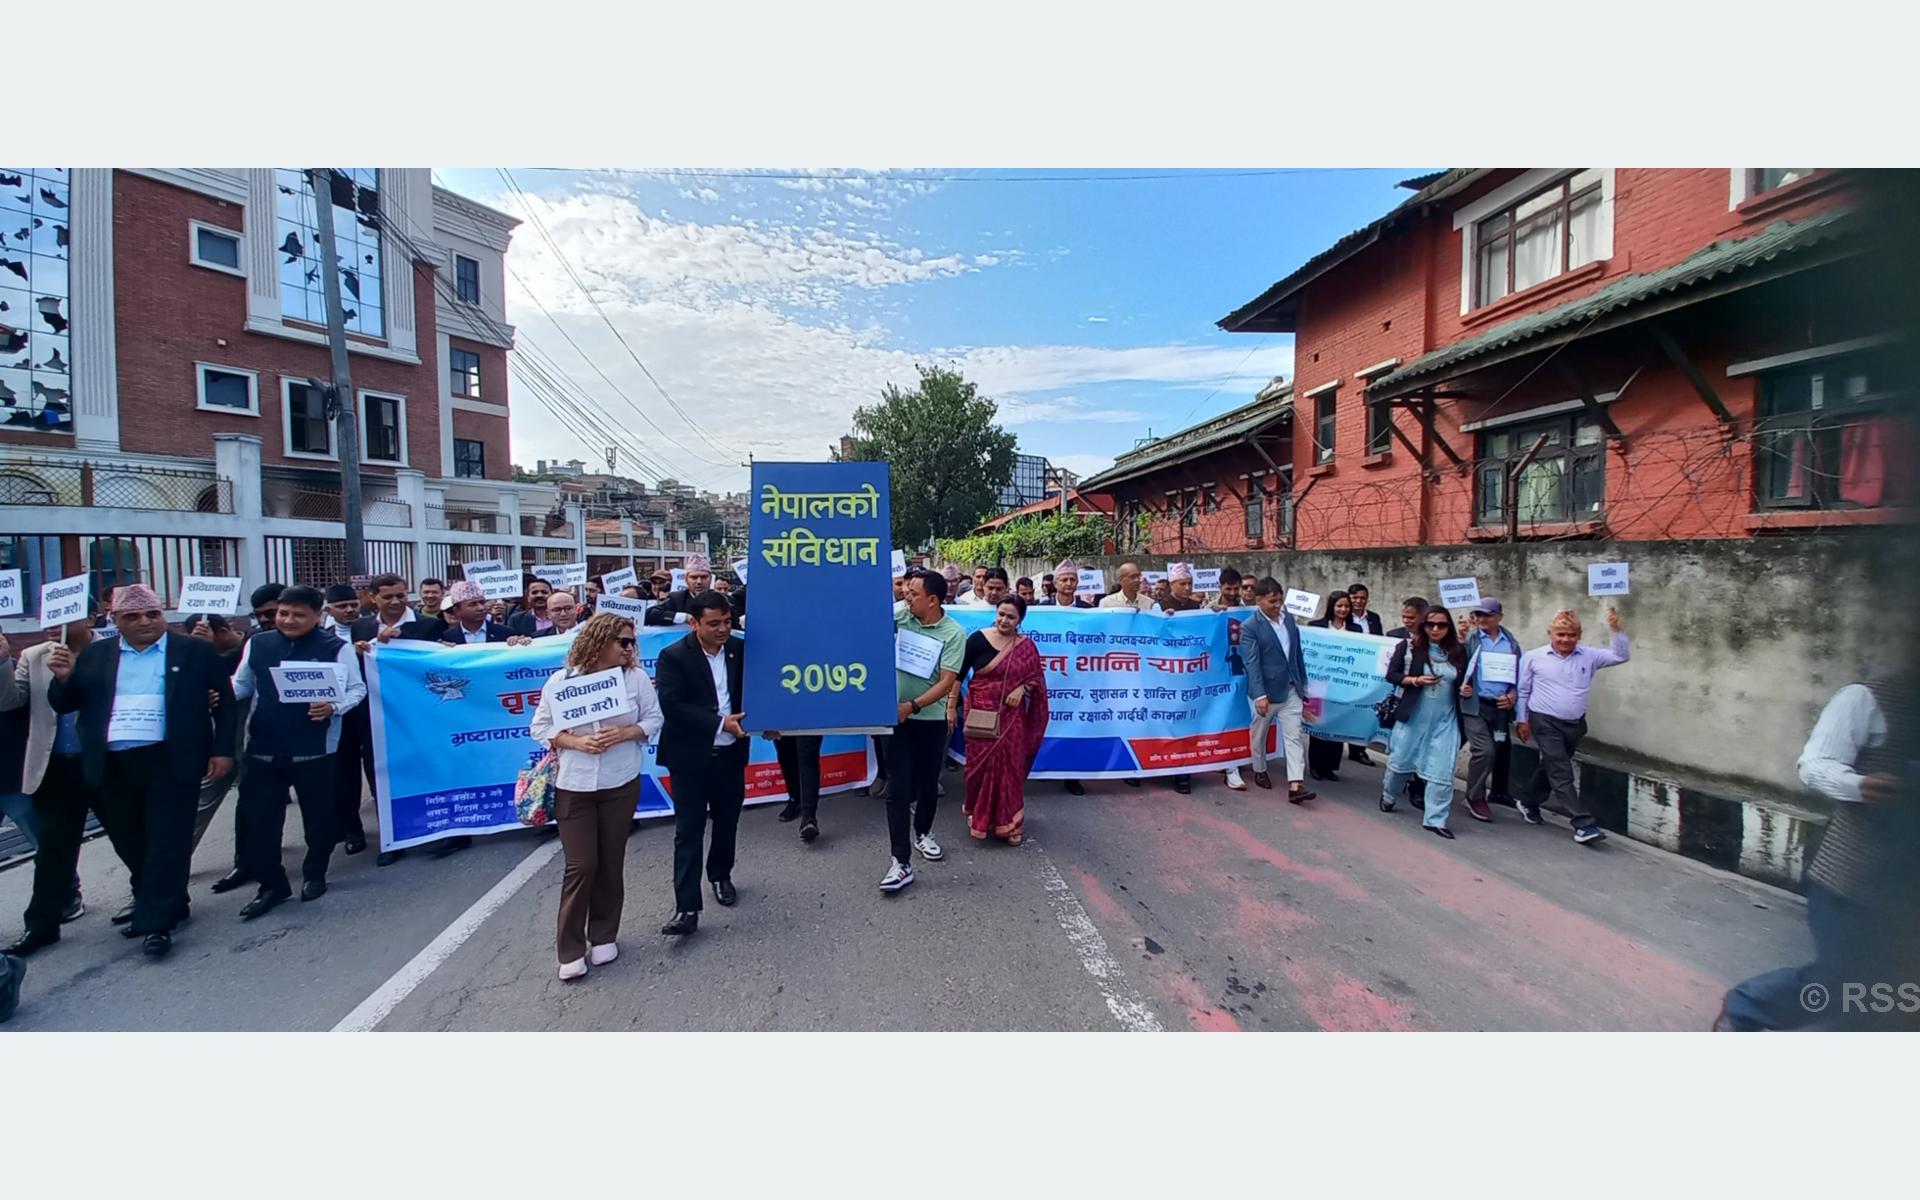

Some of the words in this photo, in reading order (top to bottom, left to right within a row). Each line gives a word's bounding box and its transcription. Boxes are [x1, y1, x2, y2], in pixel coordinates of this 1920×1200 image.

[760, 484, 880, 519] नेपालको
[761, 527, 880, 567] संविधान
[187, 581, 236, 592] संविधानको
[600, 600, 642, 613] संविधानको
[1066, 631, 1106, 645] दिवसको
[1110, 635, 1159, 646] उपलक्ष्यमा
[1076, 652, 1141, 672] शान्ति
[284, 672, 325, 683] सुशासन
[780, 662, 868, 694] २०७२
[284, 688, 316, 698] कायम
[555, 676, 618, 702] संविधानको
[1090, 689, 1128, 703] सुशासन
[1132, 689, 1140, 697] र
[1143, 686, 1176, 700] शान्ति
[562, 706, 587, 720] रक्षा
[1078, 708, 1113, 723] रक्षाको
[1151, 710, 1187, 721] कामना
